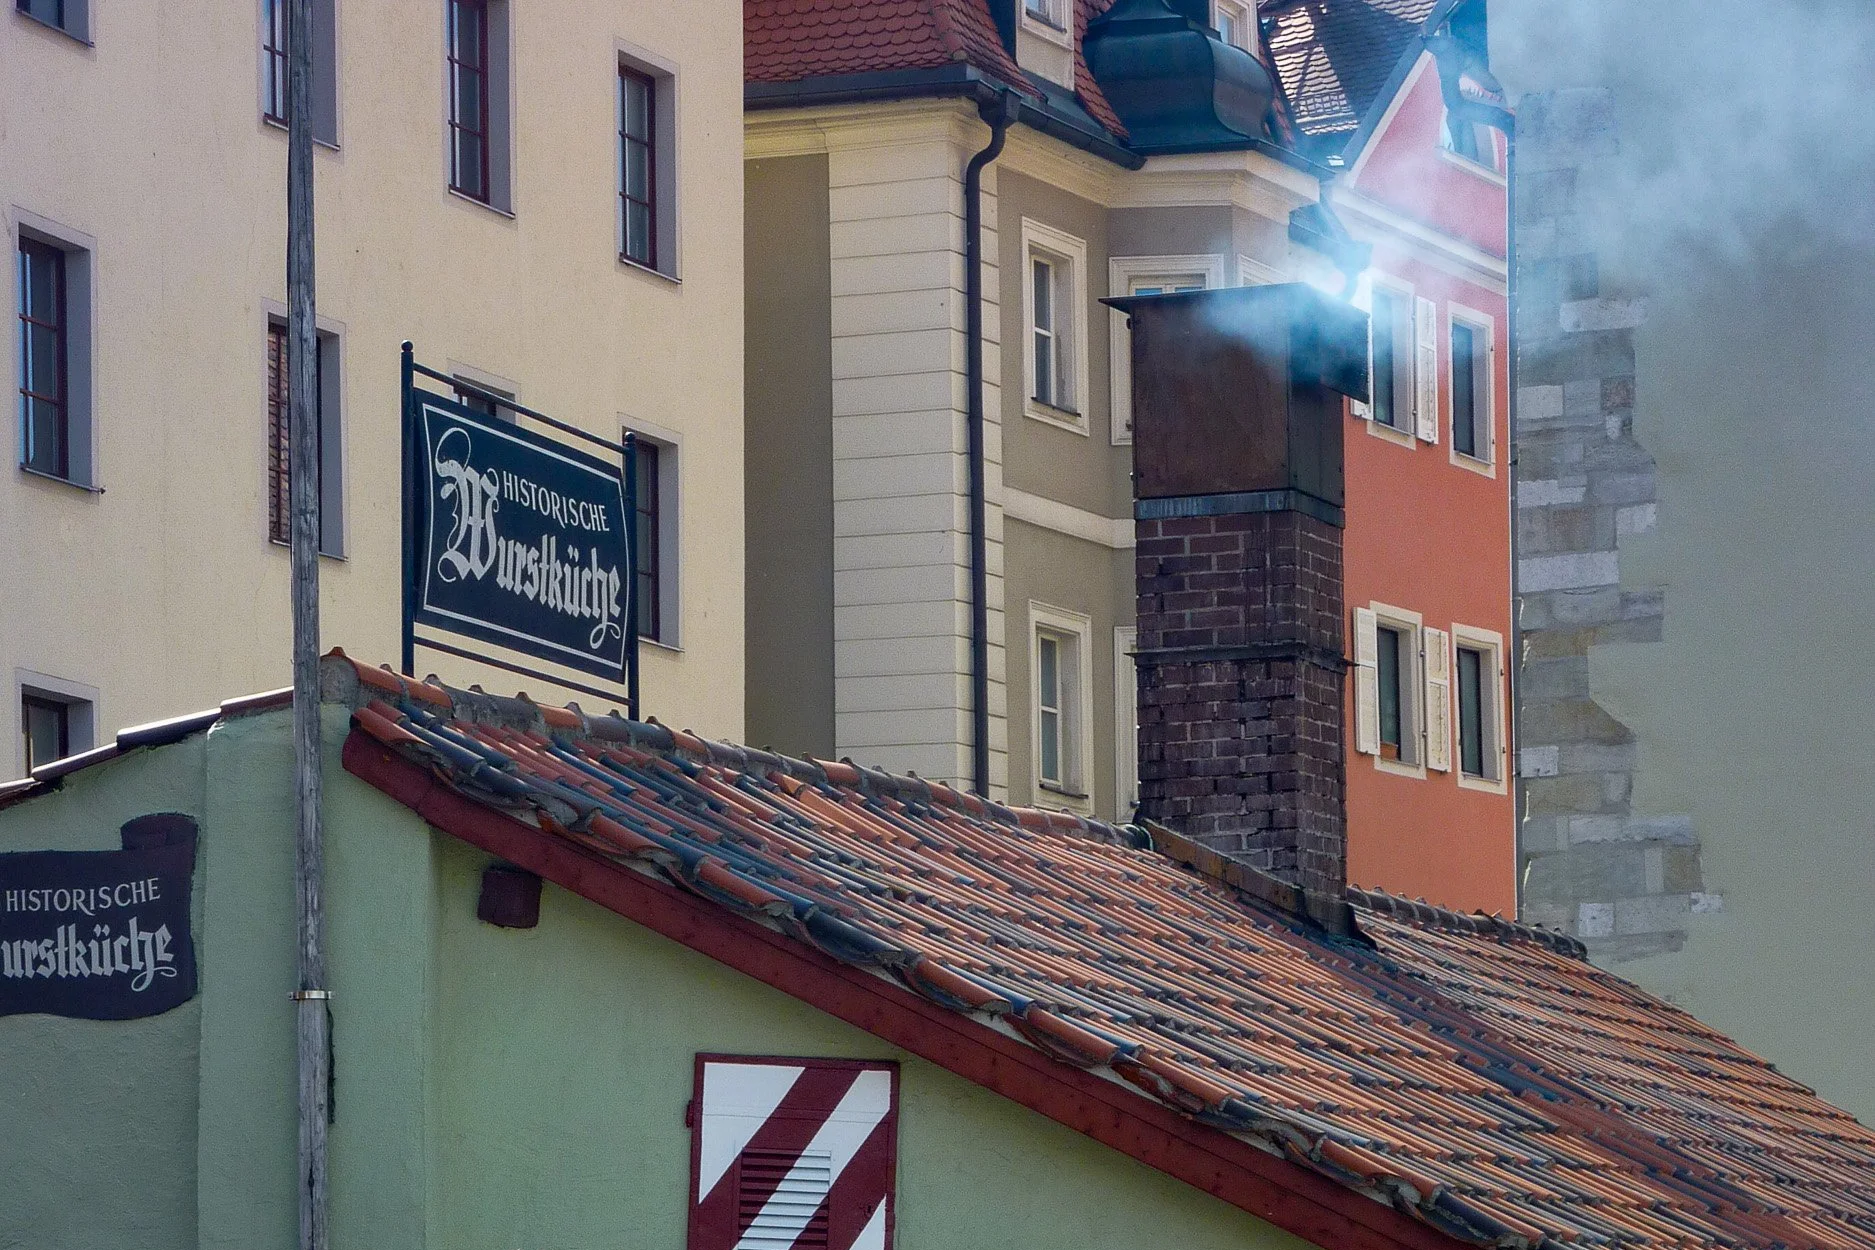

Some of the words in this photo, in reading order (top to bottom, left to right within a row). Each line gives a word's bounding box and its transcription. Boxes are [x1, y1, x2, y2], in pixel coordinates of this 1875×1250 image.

[502, 470, 610, 532] HISTORISCHE
[435, 427, 621, 649] Wurstküche
[6, 877, 160, 916] HISTORISCHE
[0, 916, 177, 992] urstküche
